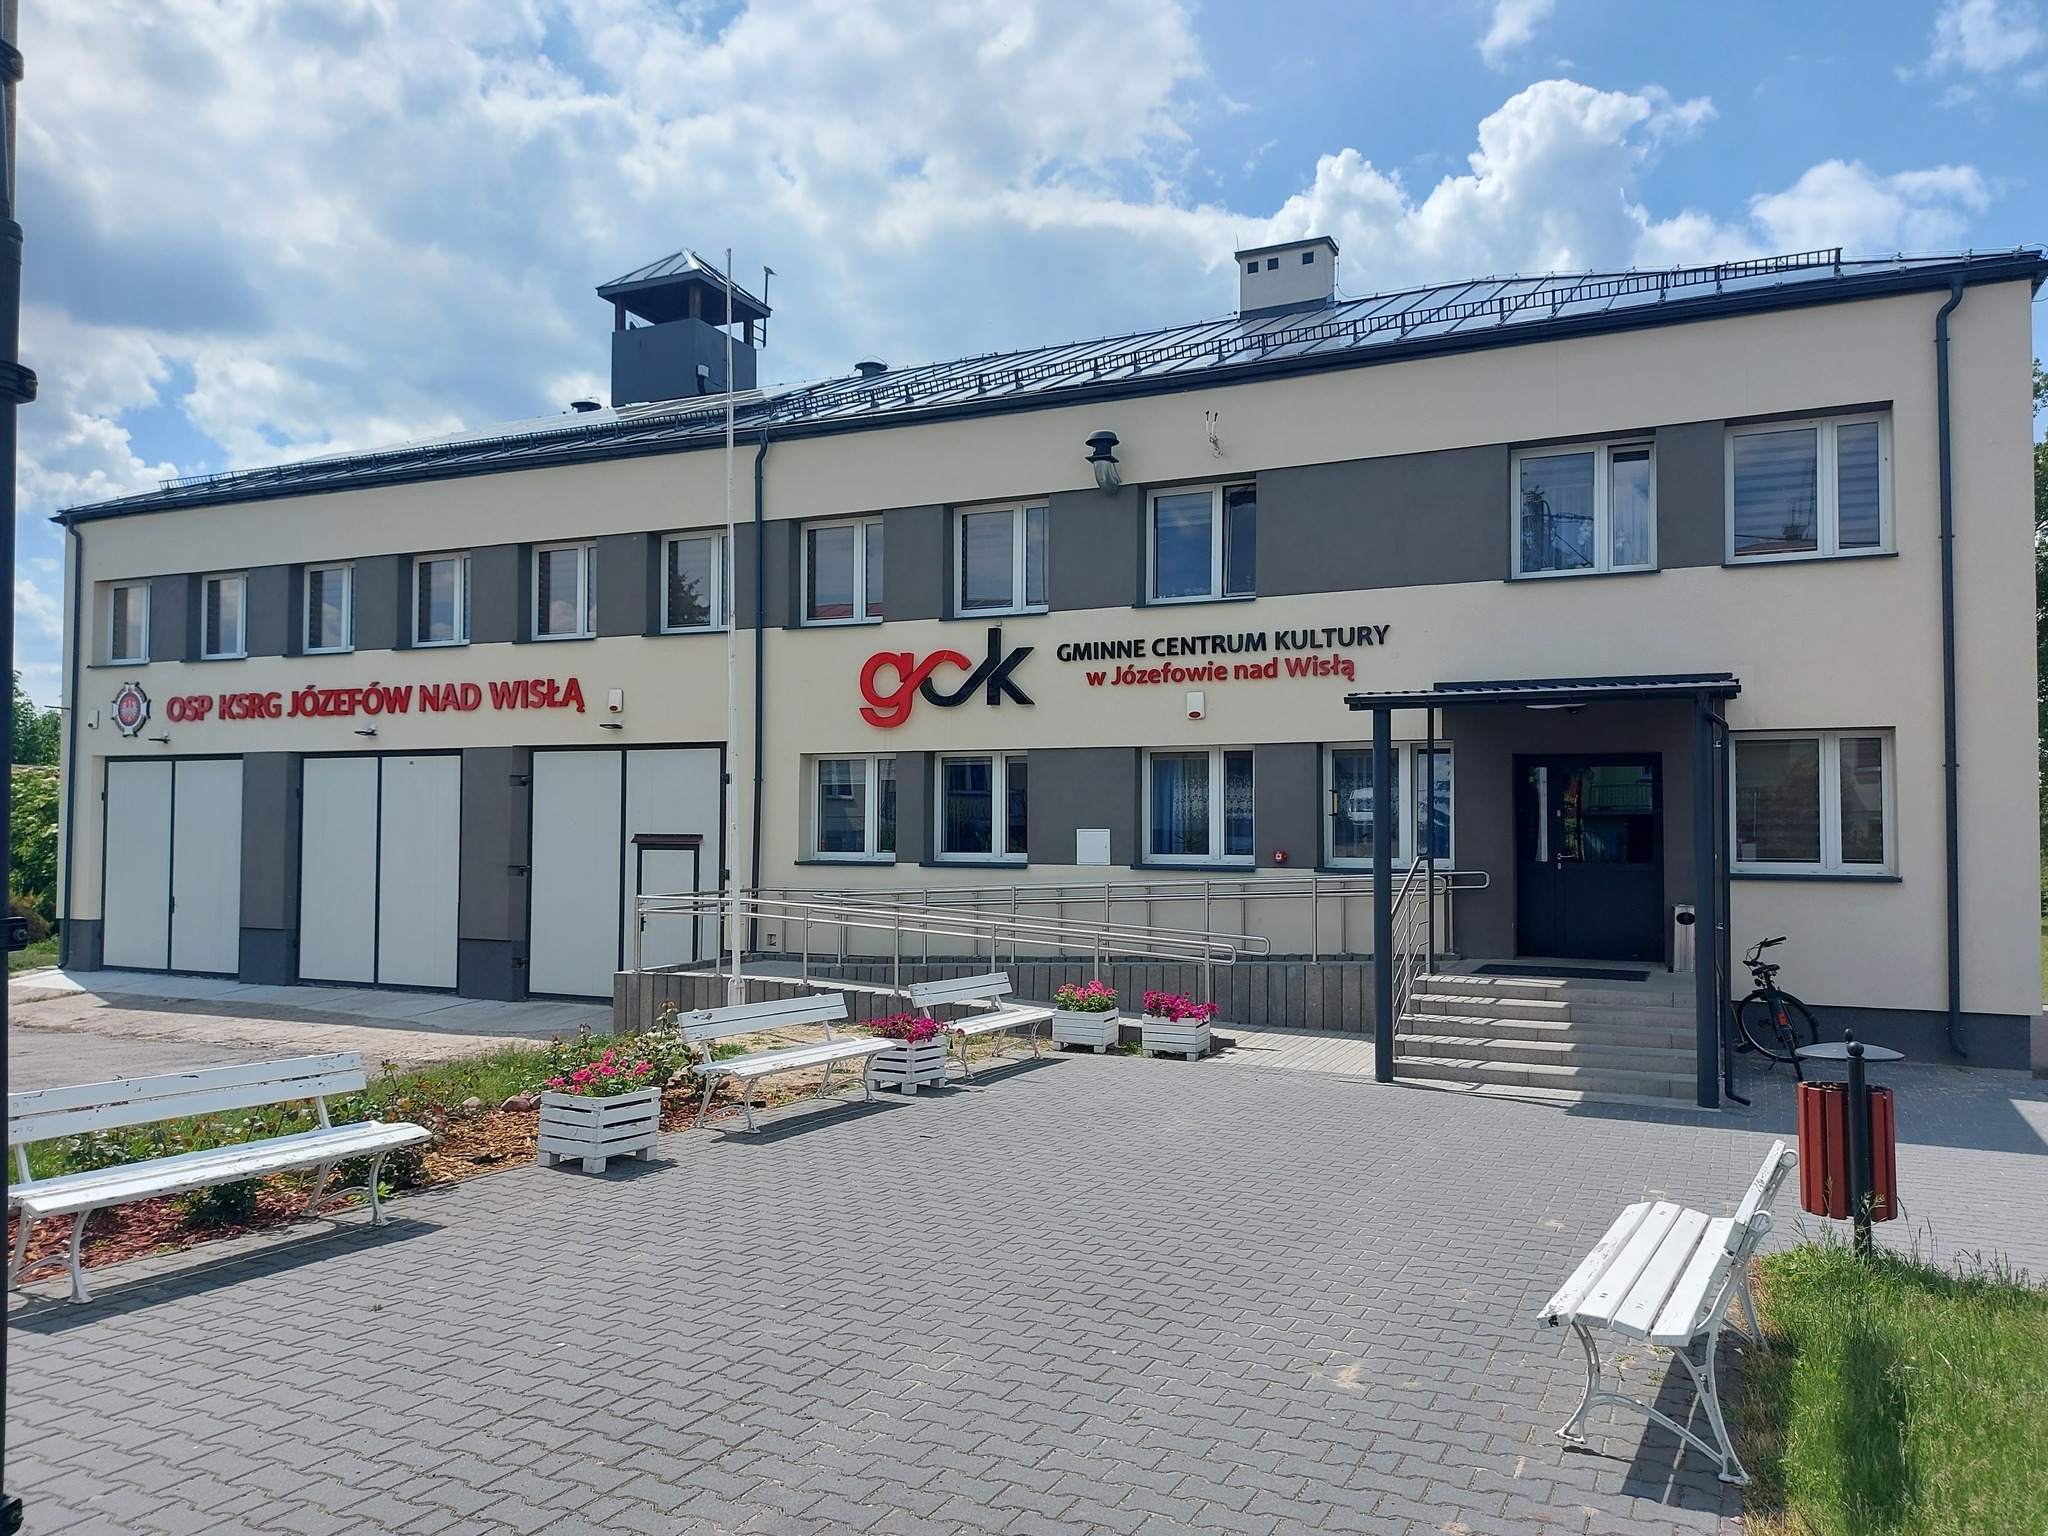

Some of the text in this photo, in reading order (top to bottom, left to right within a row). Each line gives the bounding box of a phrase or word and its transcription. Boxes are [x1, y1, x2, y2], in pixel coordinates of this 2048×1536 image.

[1056, 625, 1390, 662] GMINNE CENTRUM KULTURY
[1086, 653, 1355, 686] w Józefowie nad Wisłą
[166, 677, 585, 722] OSP KSRG JÓZEFÓW NAD WISŁĄ
